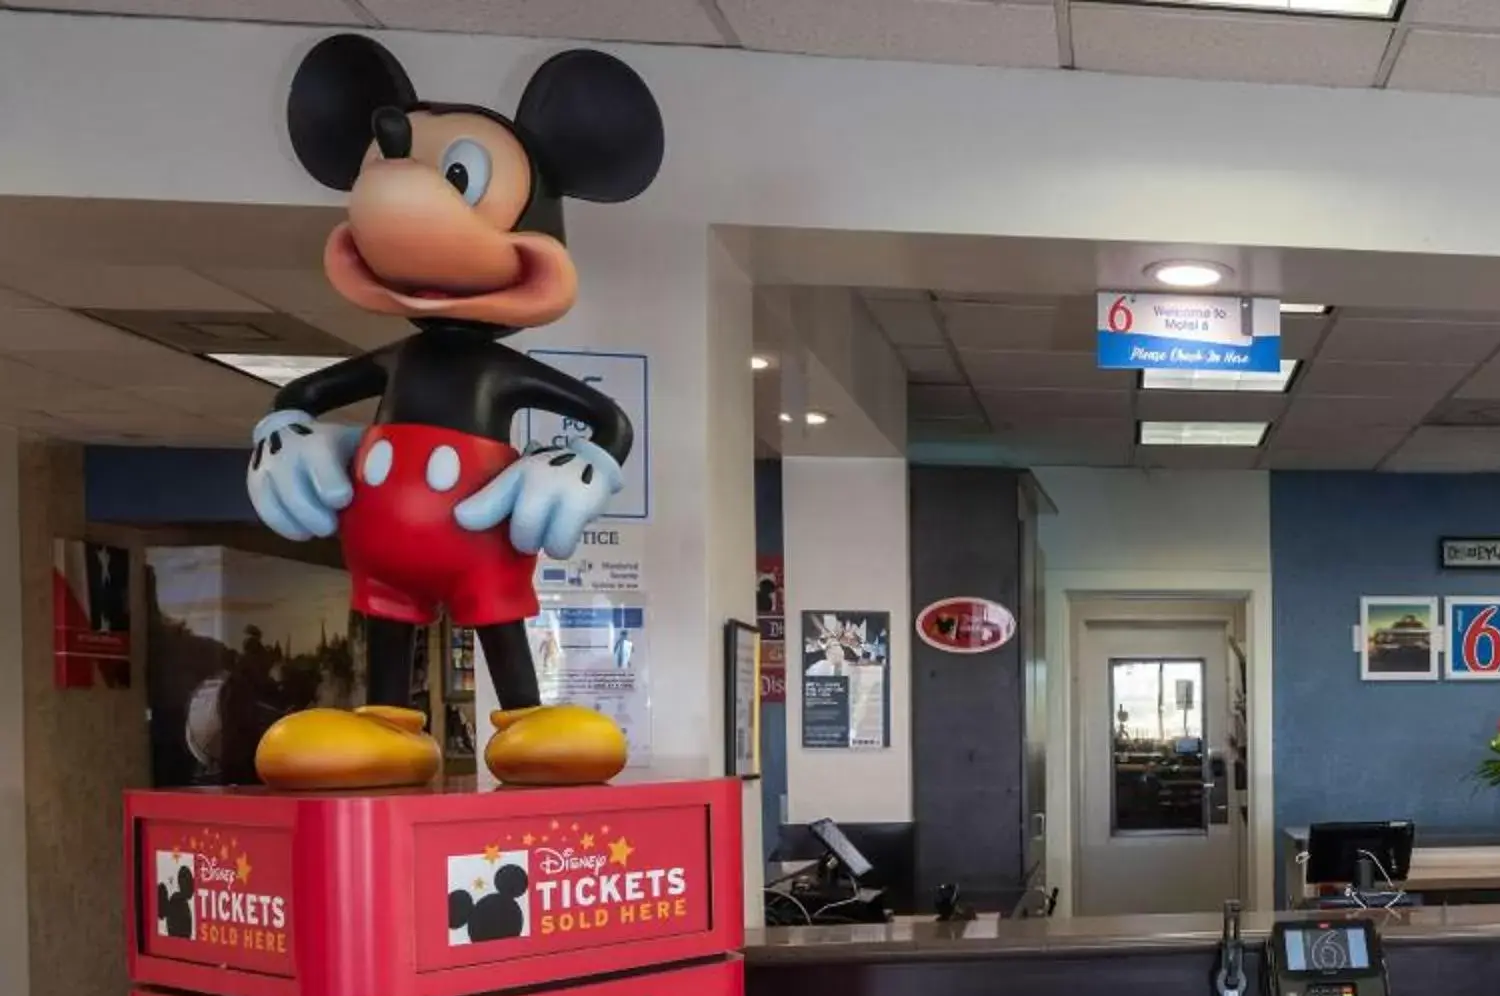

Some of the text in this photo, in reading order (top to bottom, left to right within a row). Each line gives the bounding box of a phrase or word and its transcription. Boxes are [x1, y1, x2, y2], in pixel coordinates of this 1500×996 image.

[1108, 296, 1133, 332] 6
[582, 530, 620, 545] TICE
[197, 852, 241, 890] Disney
[534, 847, 607, 877] Disney
[197, 887, 286, 929] TICKETS
[535, 867, 687, 911] TICKETS
[540, 897, 688, 935] SOLD HERE
[199, 923, 287, 953] SOLD HERE
[1311, 929, 1347, 969] 6
